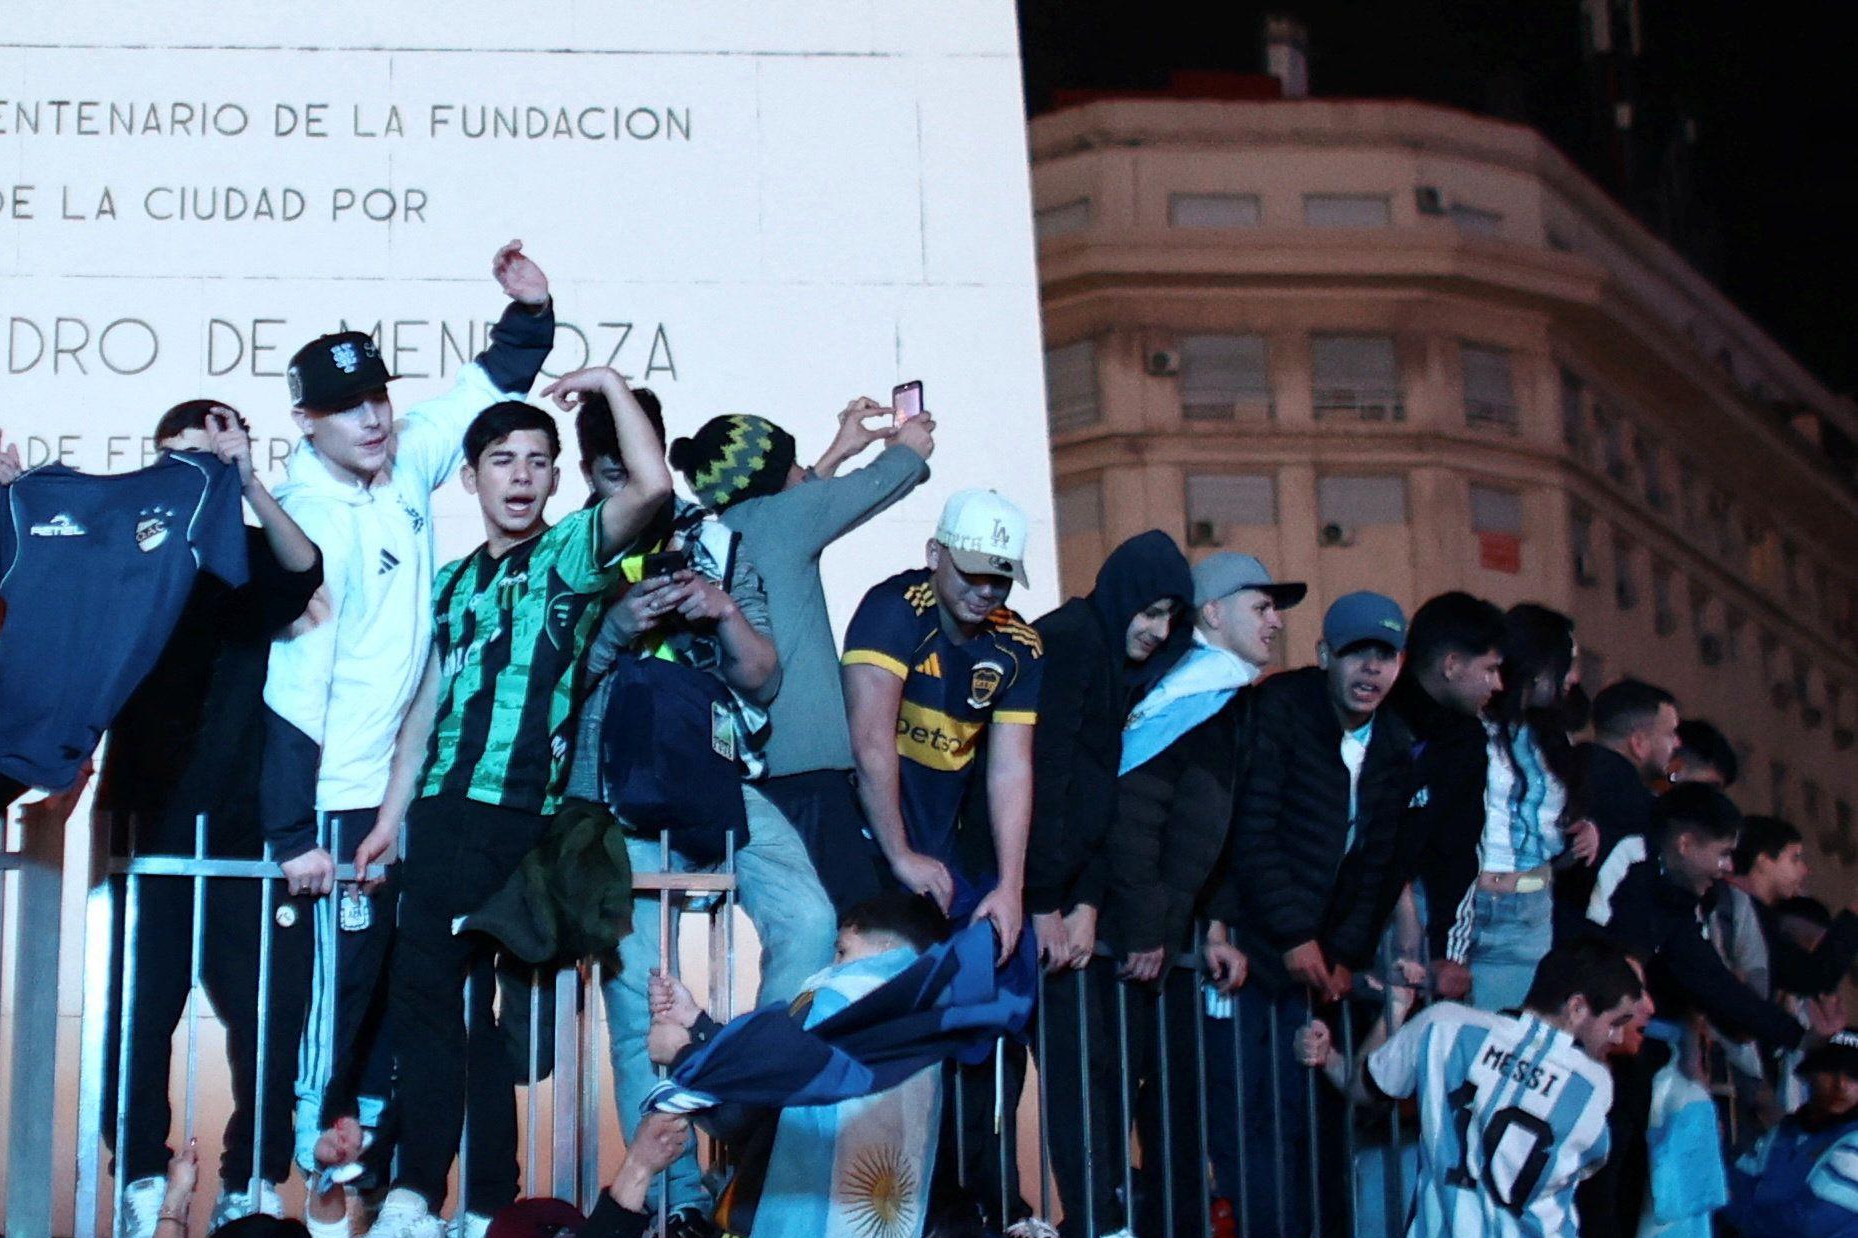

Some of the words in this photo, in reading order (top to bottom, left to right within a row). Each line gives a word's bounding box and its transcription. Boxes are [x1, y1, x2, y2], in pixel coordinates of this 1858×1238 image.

[274, 102, 330, 138] DE
[353, 103, 405, 139] LA
[429, 104, 692, 142] FUNDACION
[61, 185, 118, 221] LA
[143, 185, 307, 222] CIUDAD
[331, 187, 429, 223] POR
[206, 317, 288, 377] DE
[339, 318, 678, 381] ENOZA
[27, 434, 82, 470] DE
[1482, 1045, 1559, 1098] MESSI
[1444, 1078, 1555, 1219] 10
